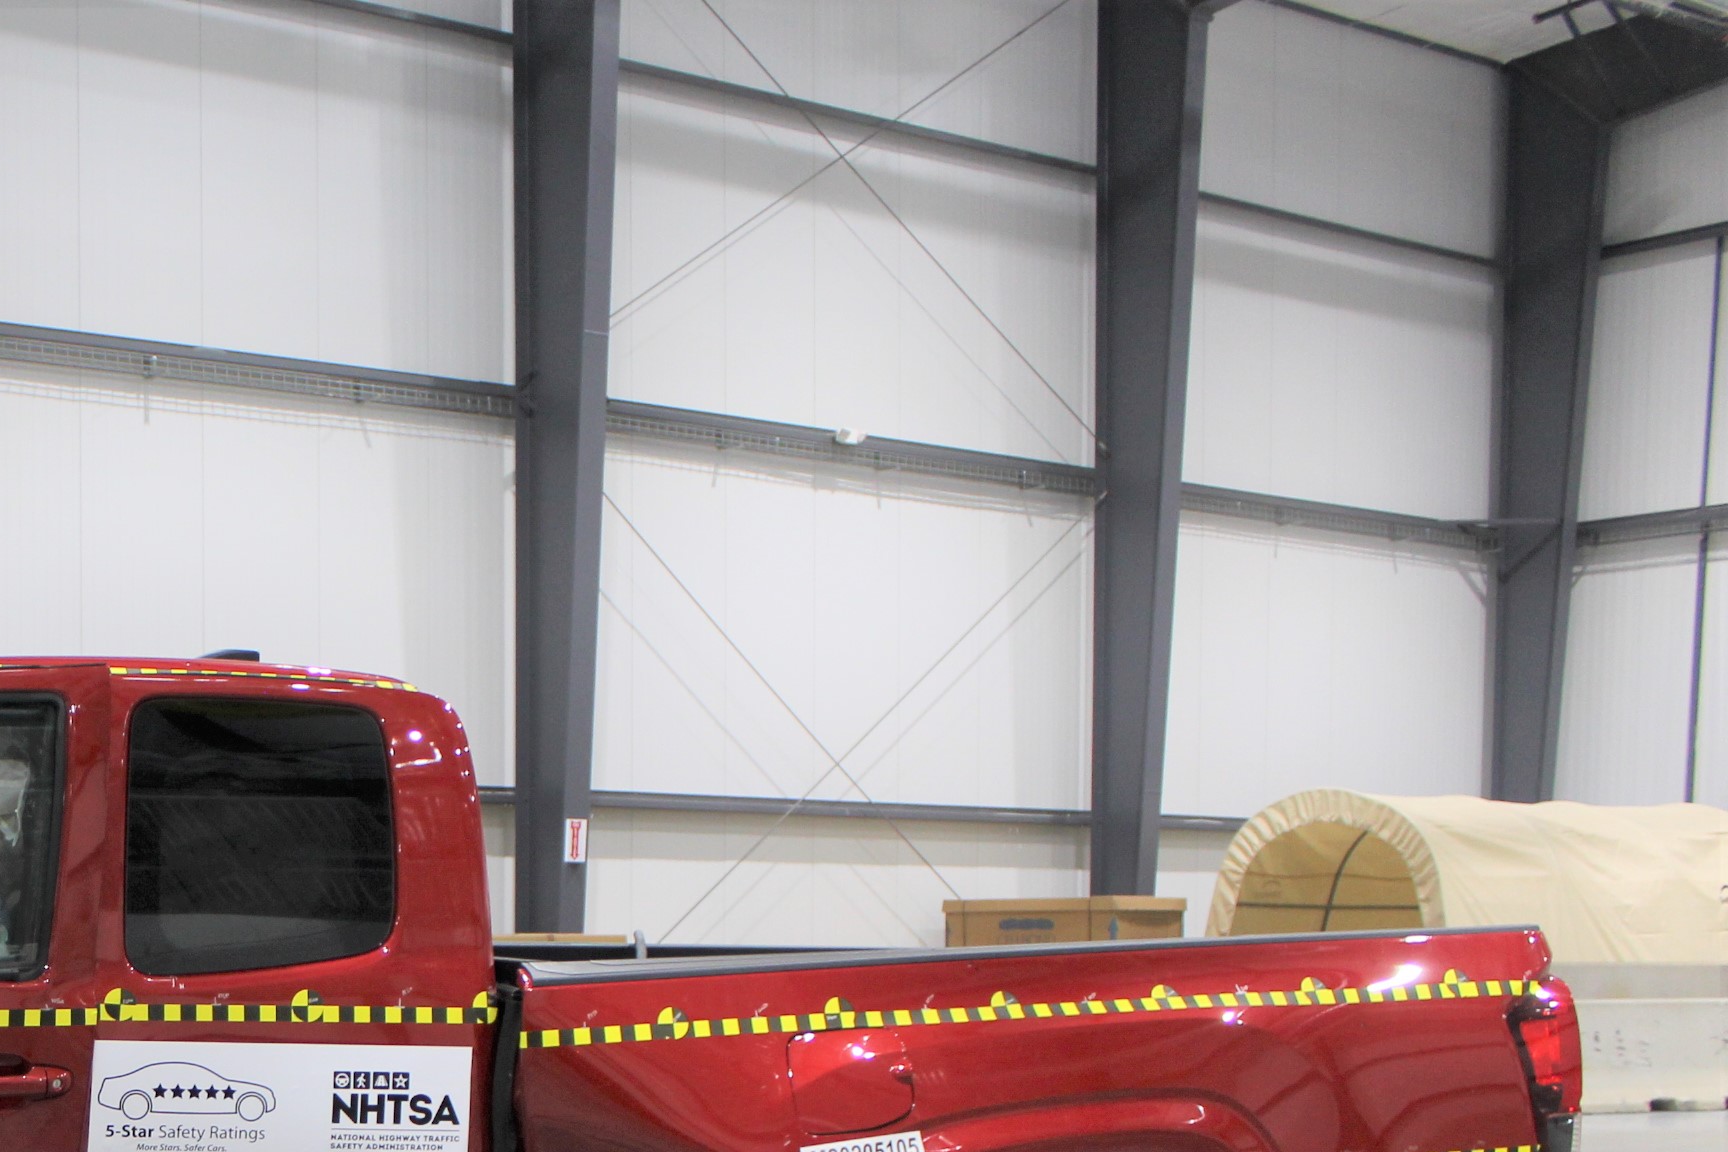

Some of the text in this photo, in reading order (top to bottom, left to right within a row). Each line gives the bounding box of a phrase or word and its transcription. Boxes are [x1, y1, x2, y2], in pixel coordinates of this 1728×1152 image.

[332, 1094, 460, 1125] NHTSA
[106, 1124, 265, 1142] 5-Star Safety Ratings
[331, 1134, 376, 1142] NATIONAL
[137, 1143, 227, 1152] More Stars. Safer Cars.
